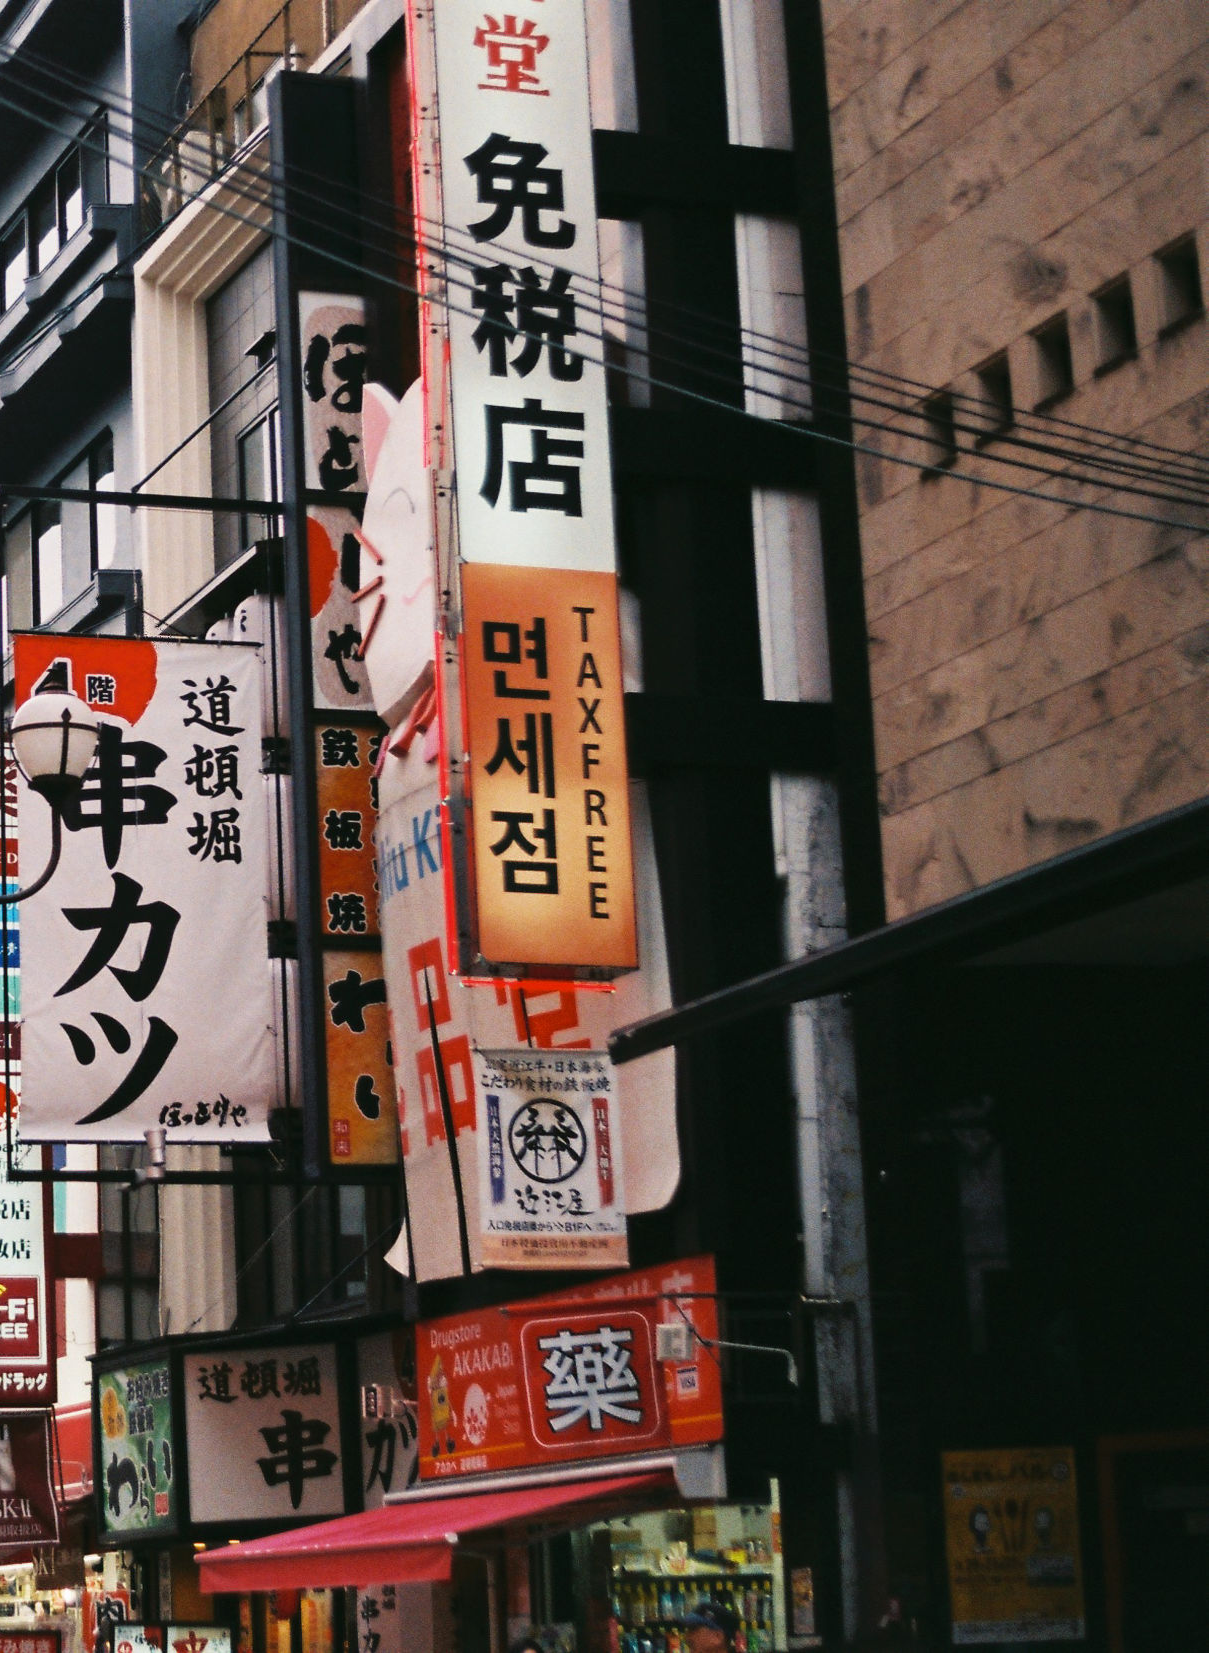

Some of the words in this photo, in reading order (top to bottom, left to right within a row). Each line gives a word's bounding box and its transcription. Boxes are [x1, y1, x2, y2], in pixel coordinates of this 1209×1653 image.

[462, 132, 586, 518] 免税店
[179, 675, 245, 864] 道頓堀
[321, 727, 367, 935] 鉄板焼
[482, 617, 559, 894] 면세점
[52, 722, 181, 1125] 串カツ
[197, 1356, 322, 1404] 道頓堀
[430, 1323, 482, 1349] Drugstore
